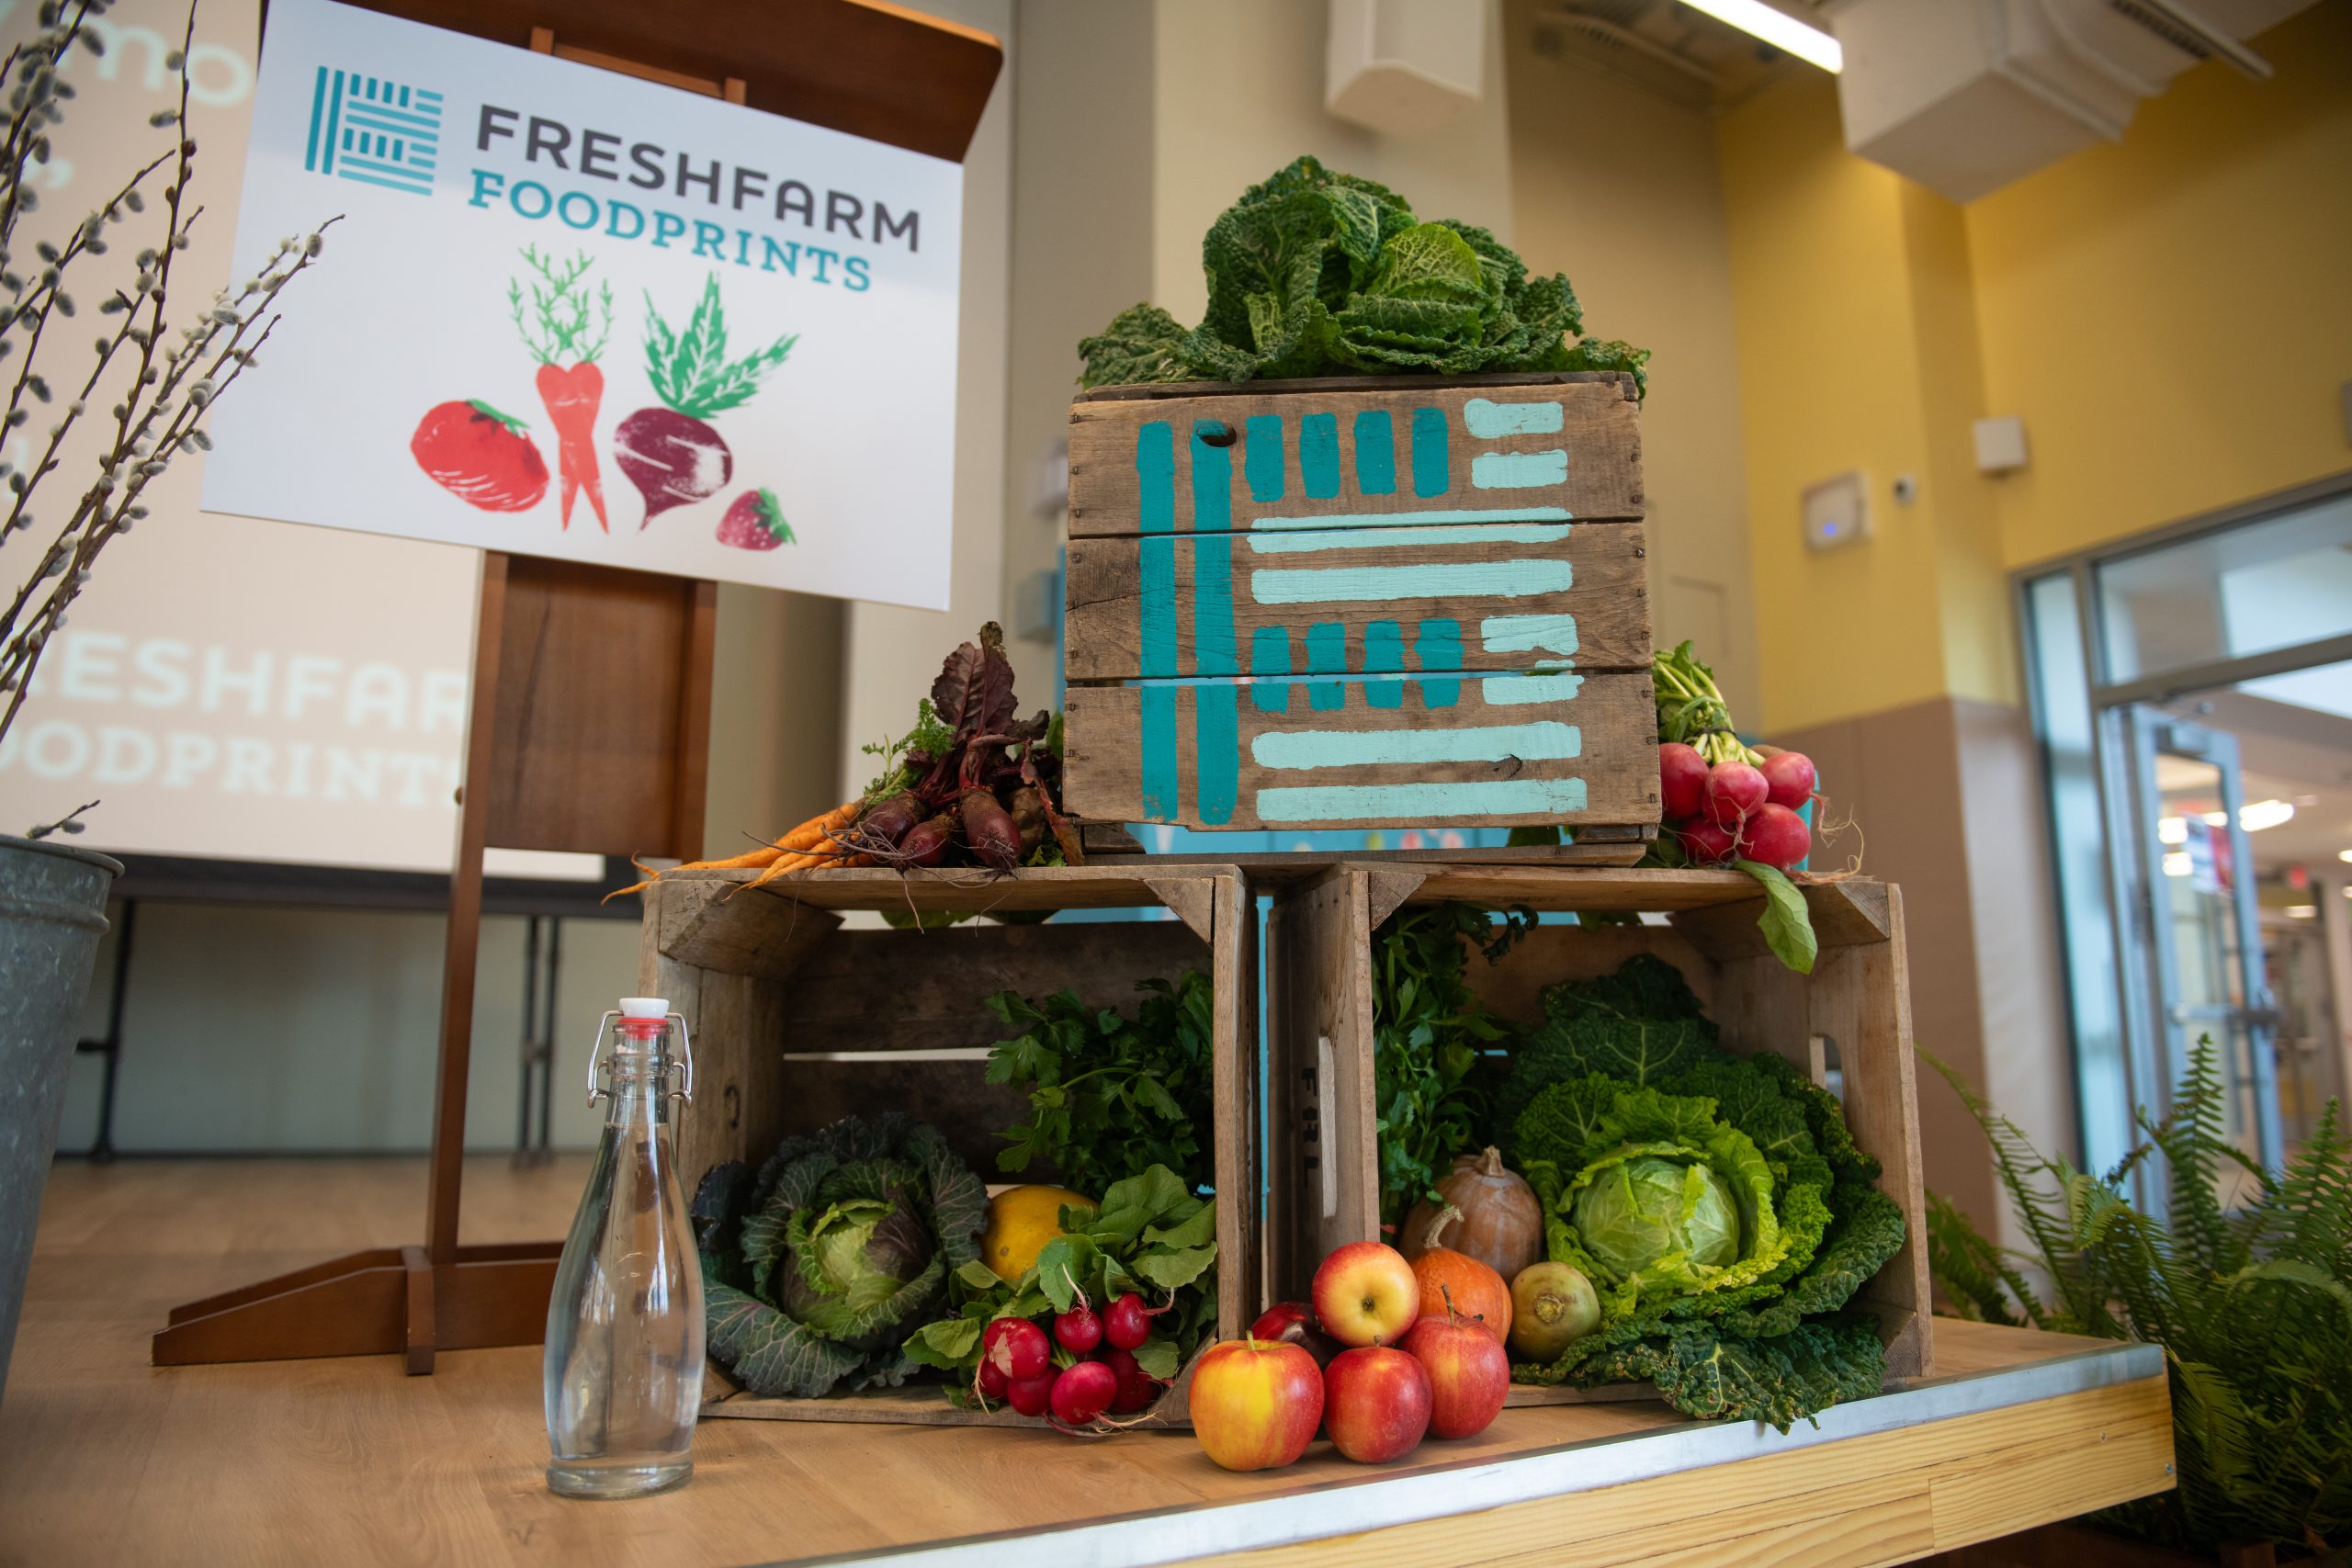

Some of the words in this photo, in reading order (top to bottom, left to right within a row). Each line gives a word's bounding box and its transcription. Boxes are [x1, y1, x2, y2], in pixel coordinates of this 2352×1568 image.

[468, 168, 872, 293] FOODPRINTS
[476, 103, 921, 254] FRESHFARM
[0, 718, 463, 808] ODPRINT
